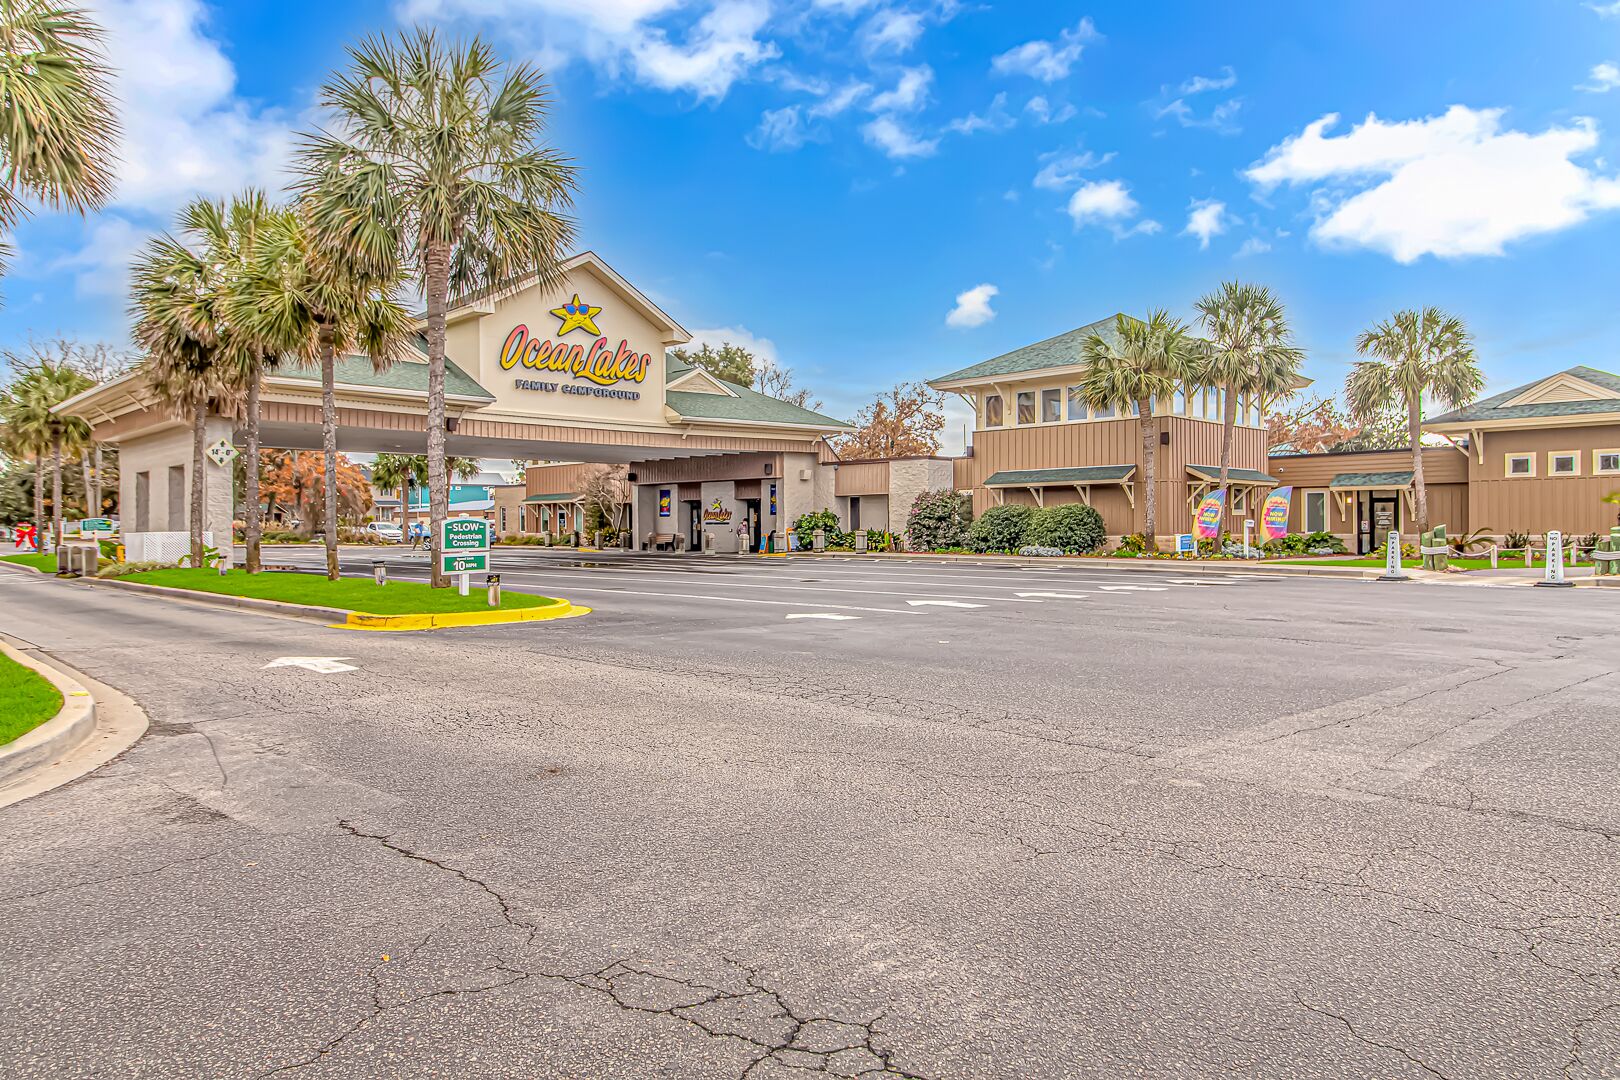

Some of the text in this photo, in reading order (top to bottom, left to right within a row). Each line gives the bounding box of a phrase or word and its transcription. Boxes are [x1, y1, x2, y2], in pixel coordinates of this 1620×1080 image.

[500, 323, 652, 386] Ocean Lakes
[515, 379, 641, 401] FAMILY CAMPGROUND
[453, 561, 465, 570] 10
